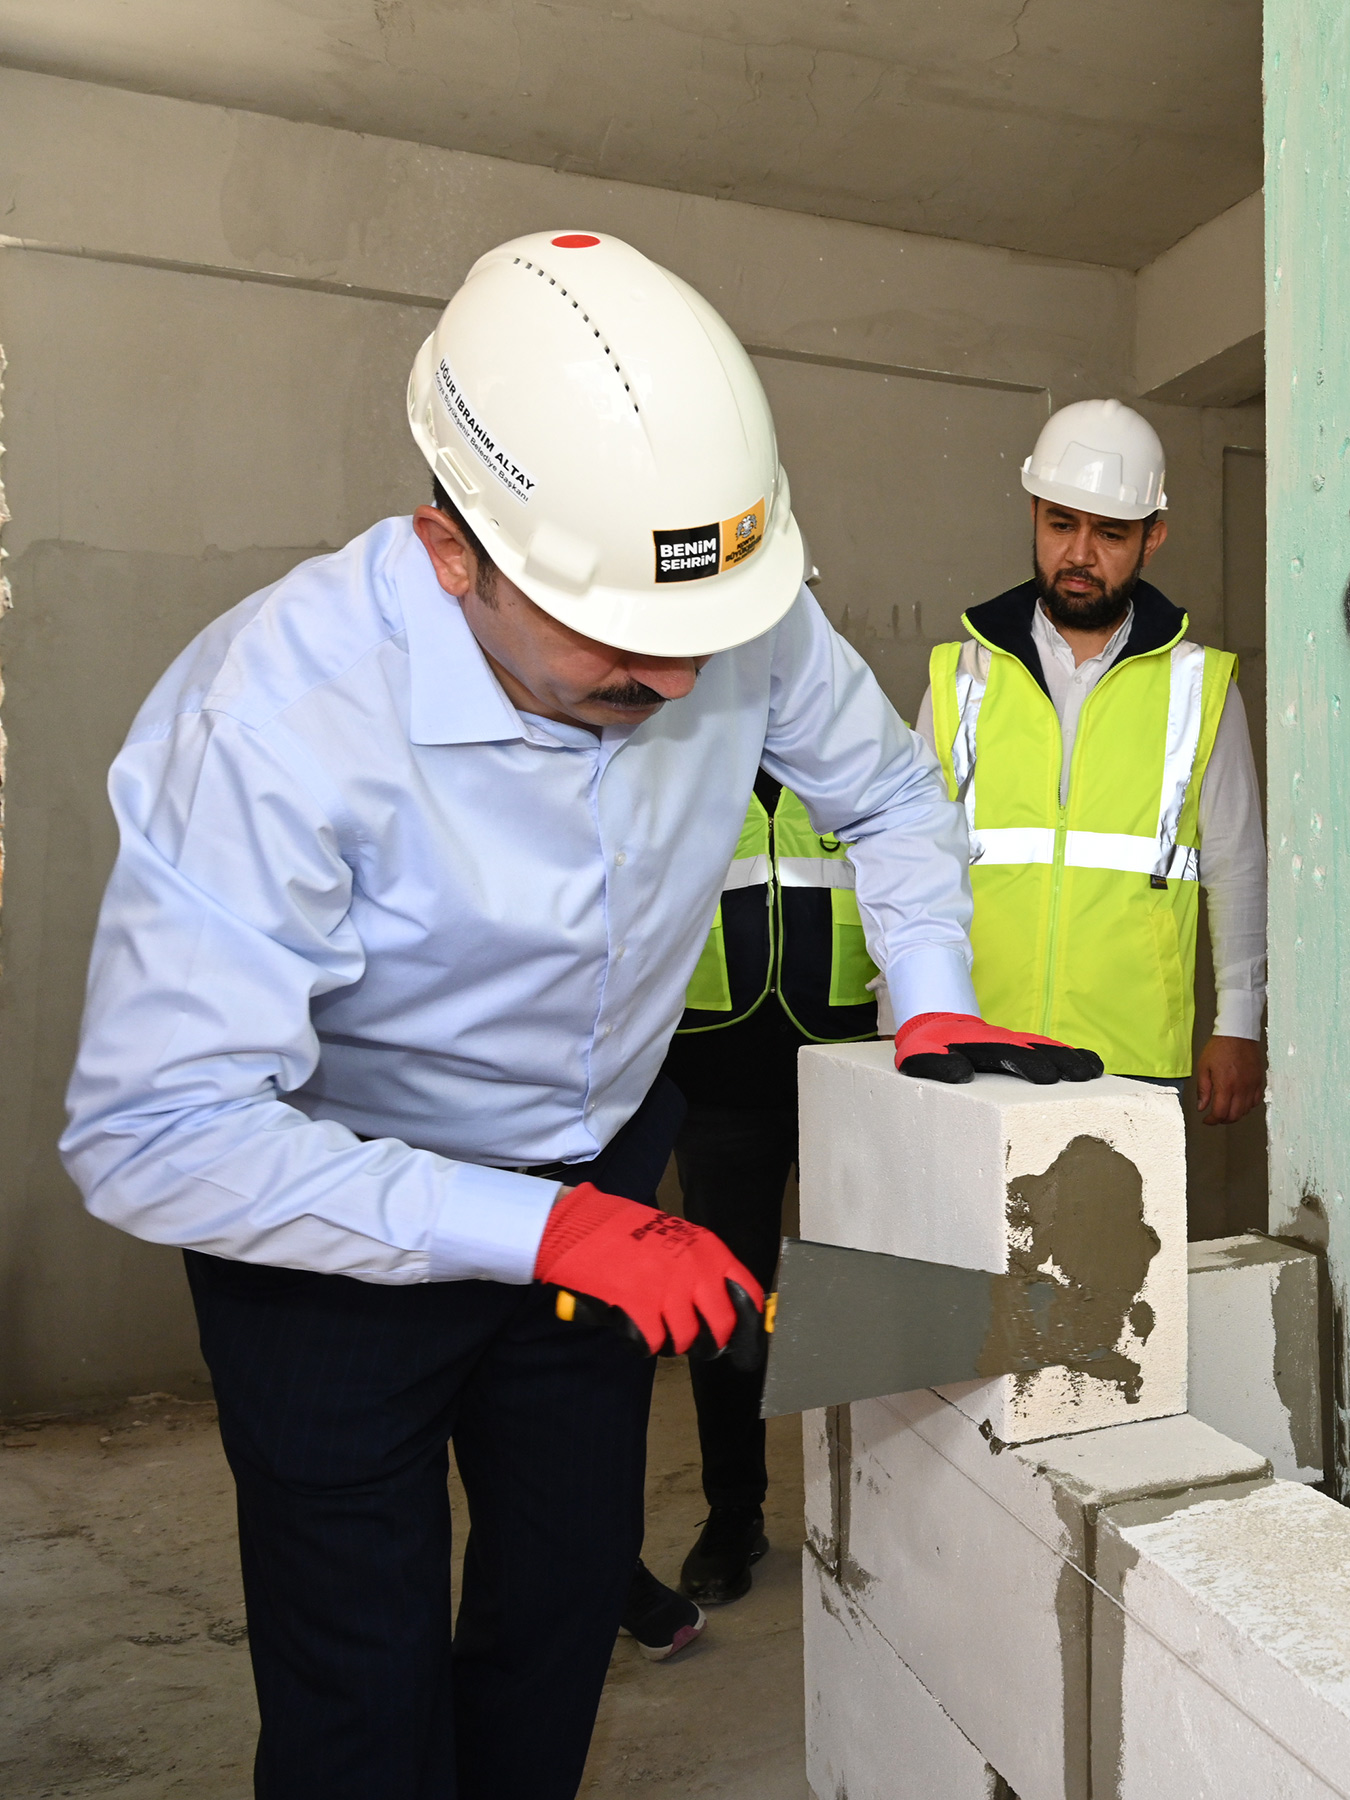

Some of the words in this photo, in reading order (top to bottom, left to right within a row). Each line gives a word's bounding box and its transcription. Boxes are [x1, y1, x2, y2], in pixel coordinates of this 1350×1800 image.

[440, 358, 457, 397] UĞUR
[455, 393, 495, 452] İBRAHİM
[494, 452, 536, 491] ALTAY
[470, 437, 497, 472] Belediye
[497, 468, 529, 502] Başkanı
